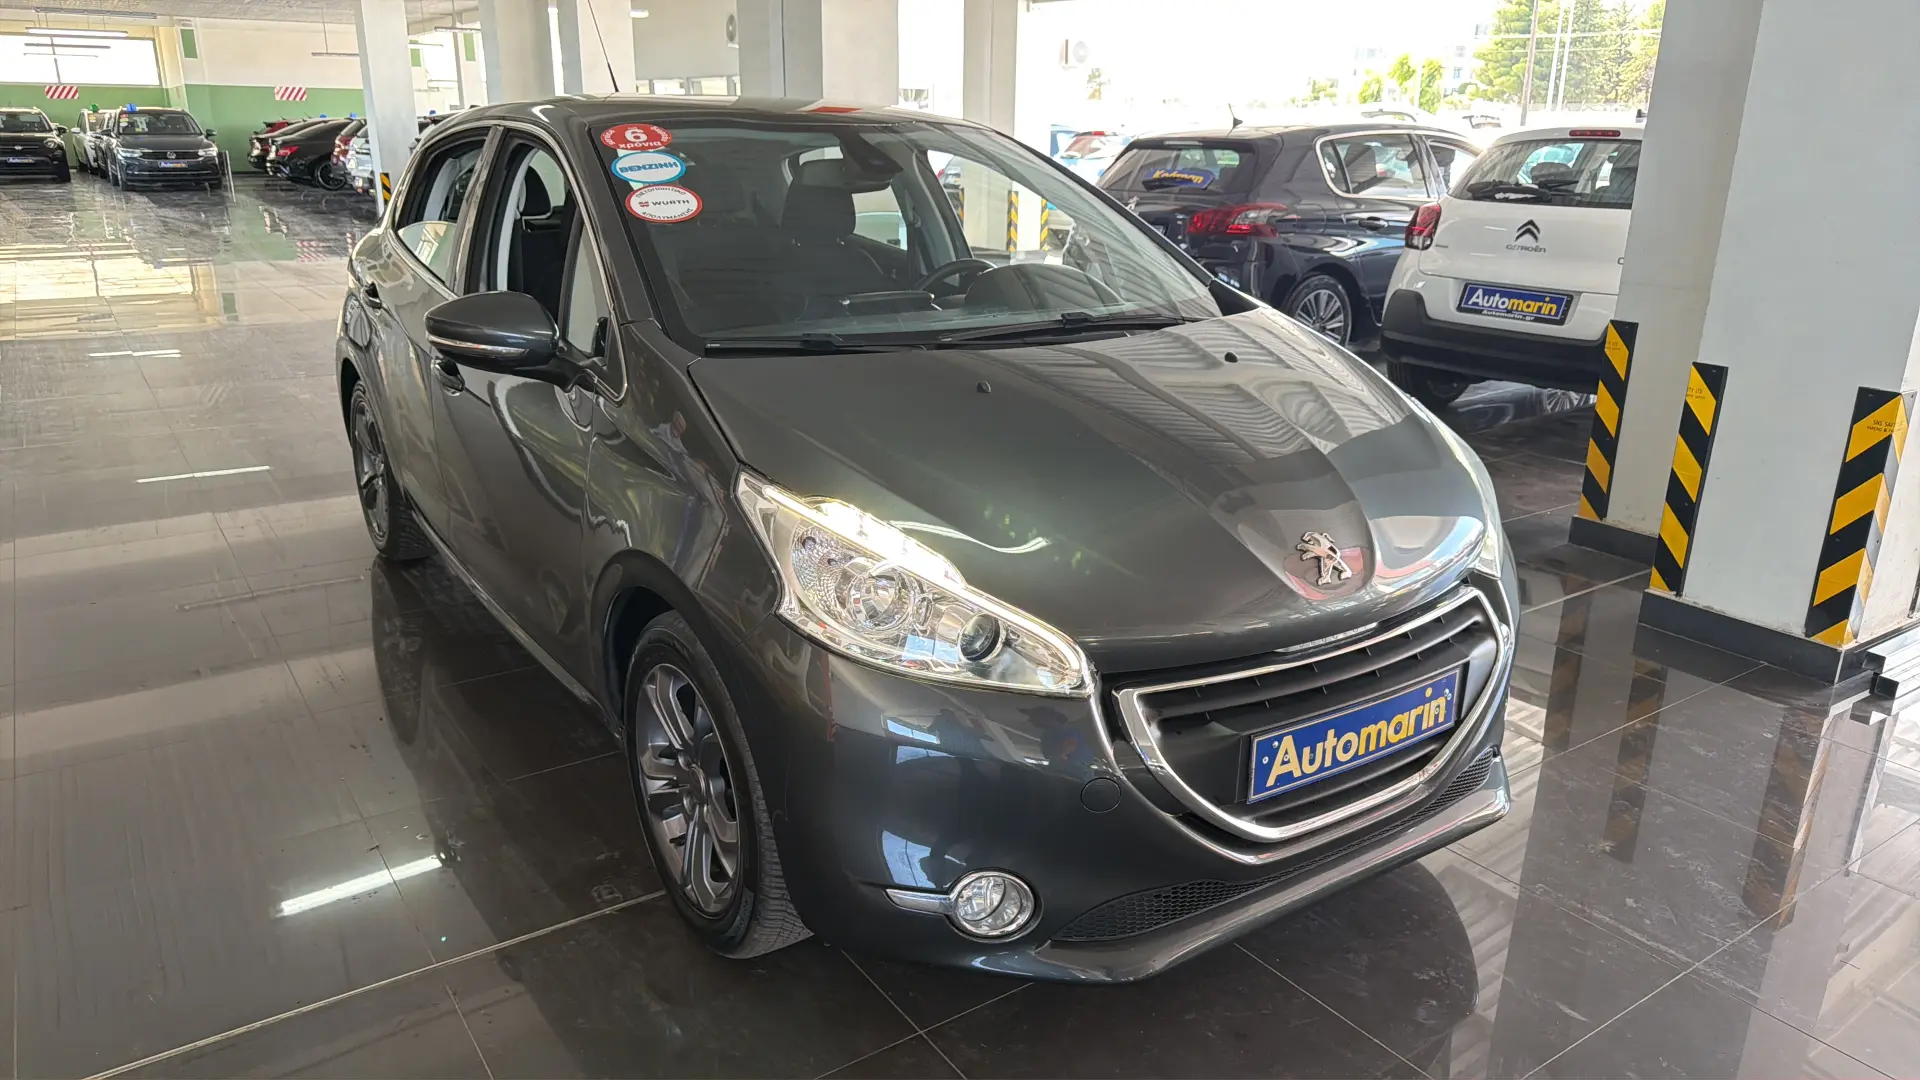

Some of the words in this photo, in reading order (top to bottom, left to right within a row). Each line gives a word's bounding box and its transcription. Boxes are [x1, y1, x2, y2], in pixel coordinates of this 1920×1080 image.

[625, 129, 648, 142] 6
[1468, 288, 1557, 316] Automarin
[1265, 686, 1447, 788] Automarin
